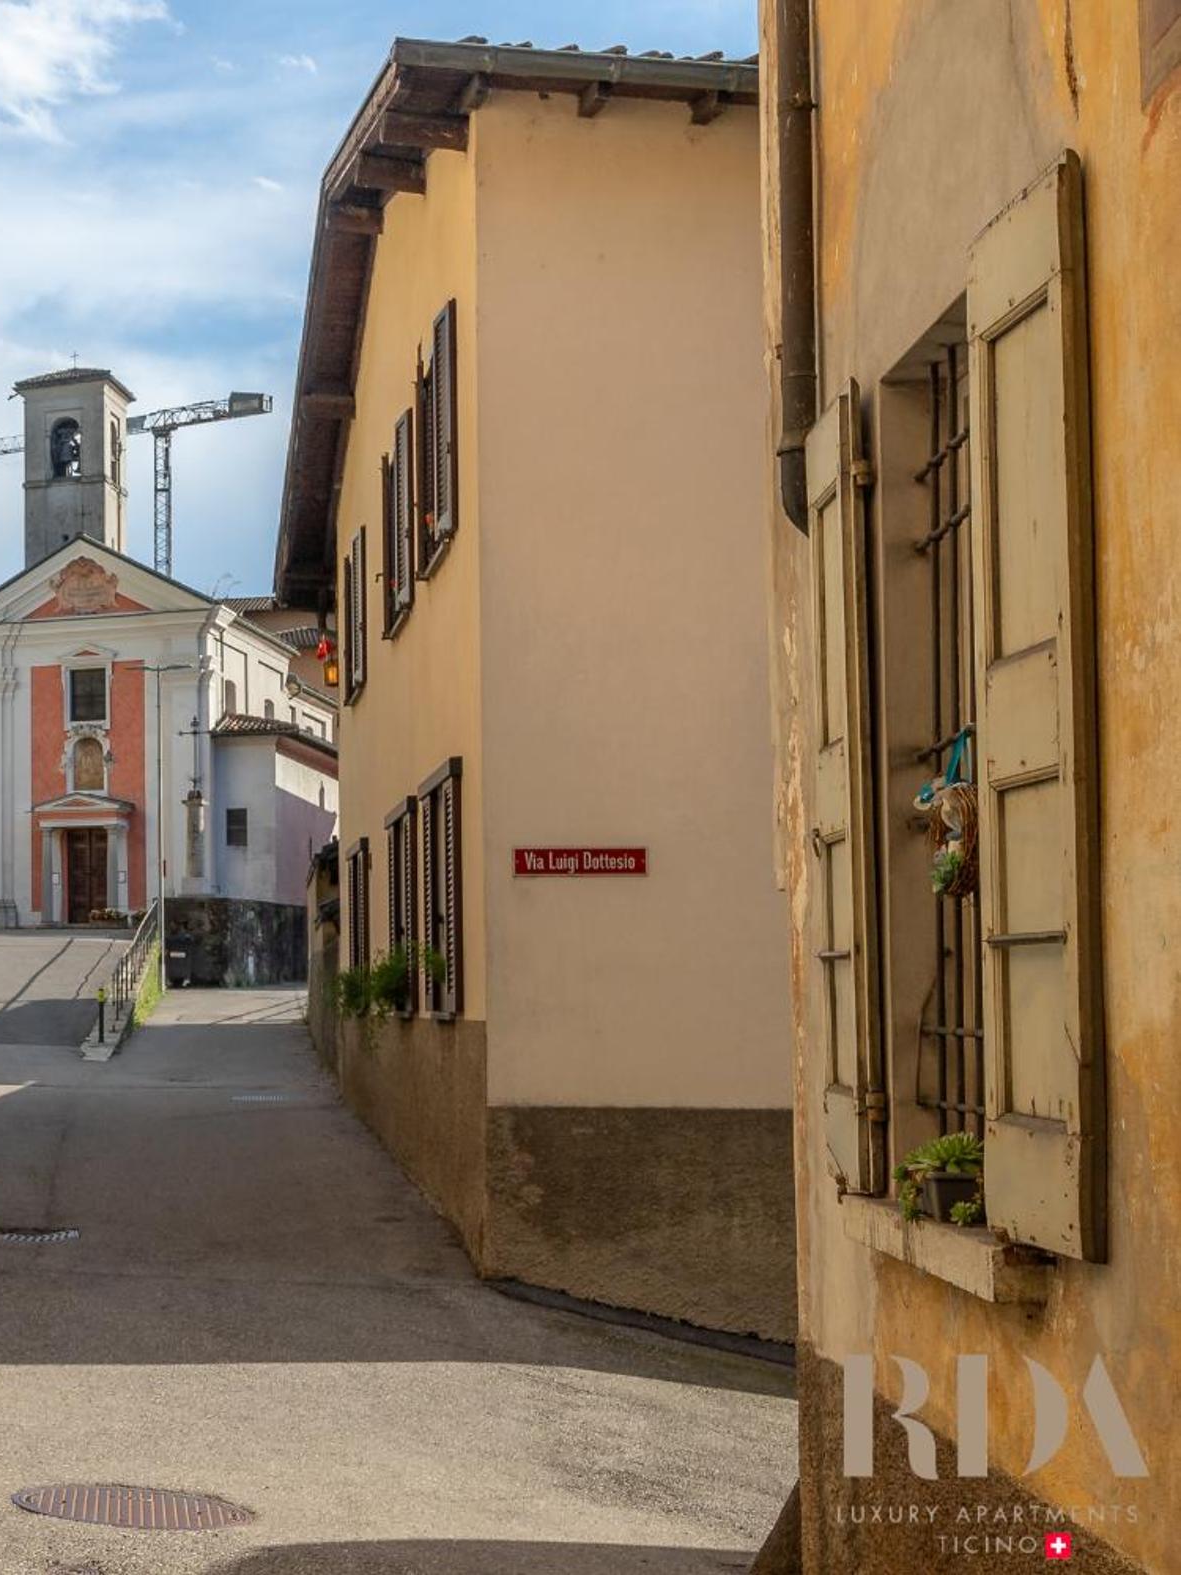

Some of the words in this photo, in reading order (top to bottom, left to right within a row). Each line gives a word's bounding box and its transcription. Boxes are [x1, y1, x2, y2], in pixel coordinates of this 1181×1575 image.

[524, 851, 544, 870] Via
[549, 851, 579, 873] Luigi
[583, 851, 636, 870] Dottesio
